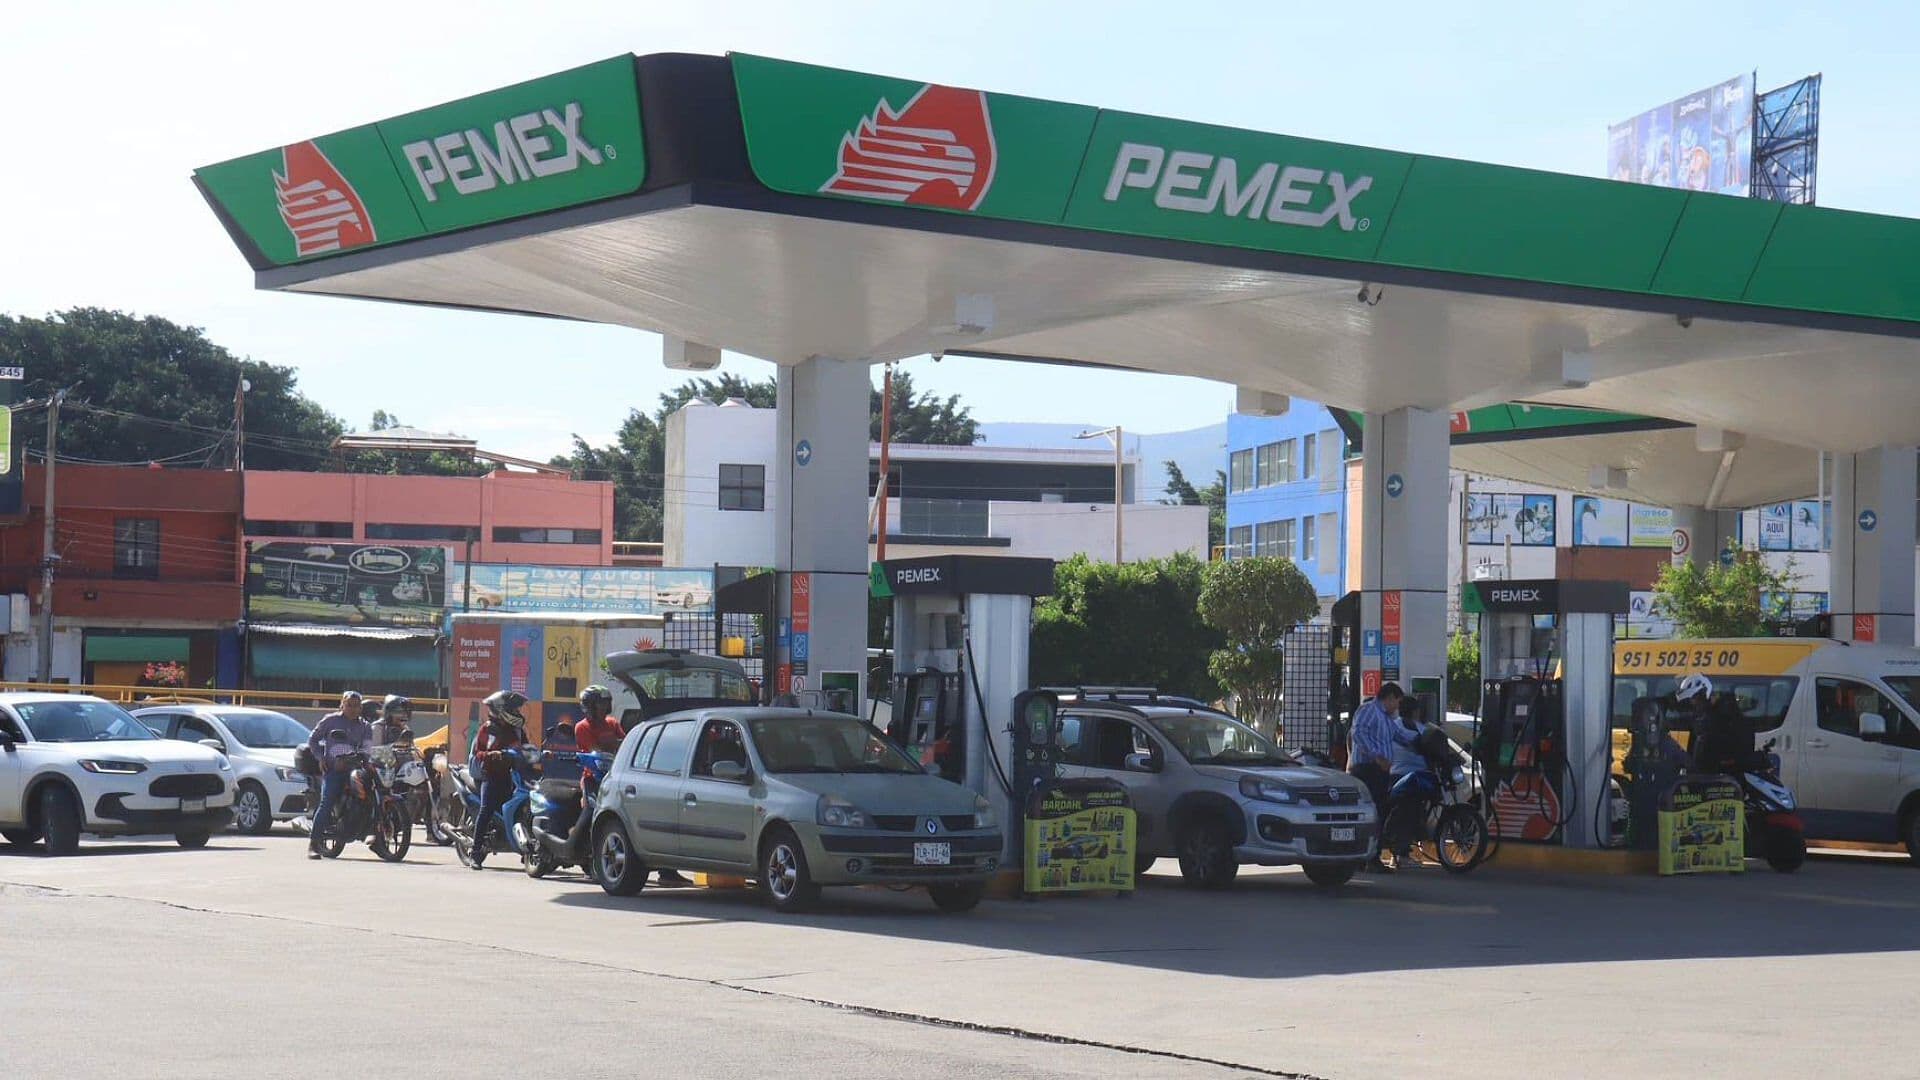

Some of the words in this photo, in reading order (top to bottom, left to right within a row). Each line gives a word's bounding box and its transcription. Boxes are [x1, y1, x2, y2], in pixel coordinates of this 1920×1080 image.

[402, 102, 602, 202] PEMEX
[1103, 142, 1373, 231] PEMEX
[531, 570, 580, 580] LAVA
[591, 571, 655, 581] AUTOS
[897, 568, 940, 584] PEMEX
[1491, 589, 1539, 602] PEMEX
[1623, 651, 1650, 667] 951
[1656, 651, 1687, 667] 502
[1692, 651, 1712, 667] 35
[1718, 650, 1739, 666] 00
[1043, 800, 1082, 810] BARDAHL
